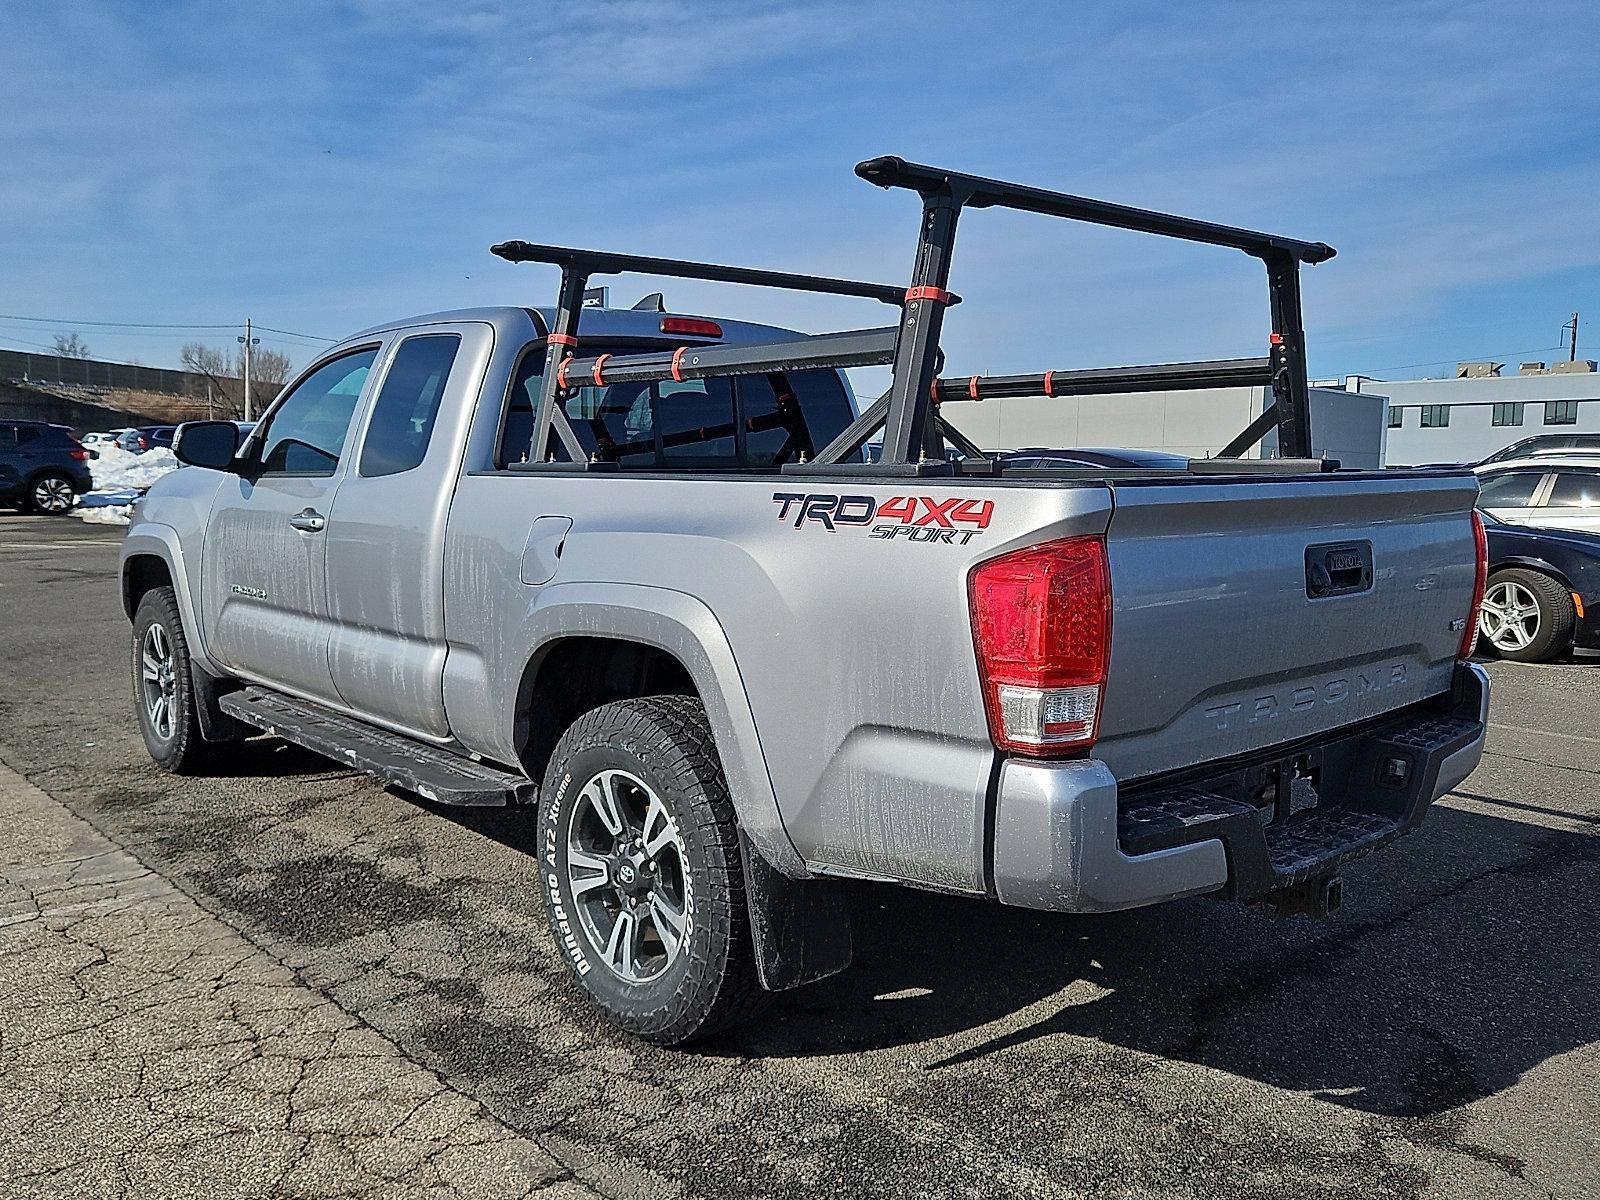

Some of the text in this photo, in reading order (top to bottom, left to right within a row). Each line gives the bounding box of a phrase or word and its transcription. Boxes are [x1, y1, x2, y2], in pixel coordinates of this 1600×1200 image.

[771, 492, 995, 533] TRD 4X4
[868, 524, 984, 546] SPORT
[1204, 662, 1408, 730] TACOMA
[548, 772, 574, 824] Xtreme
[546, 828, 558, 867] AT2
